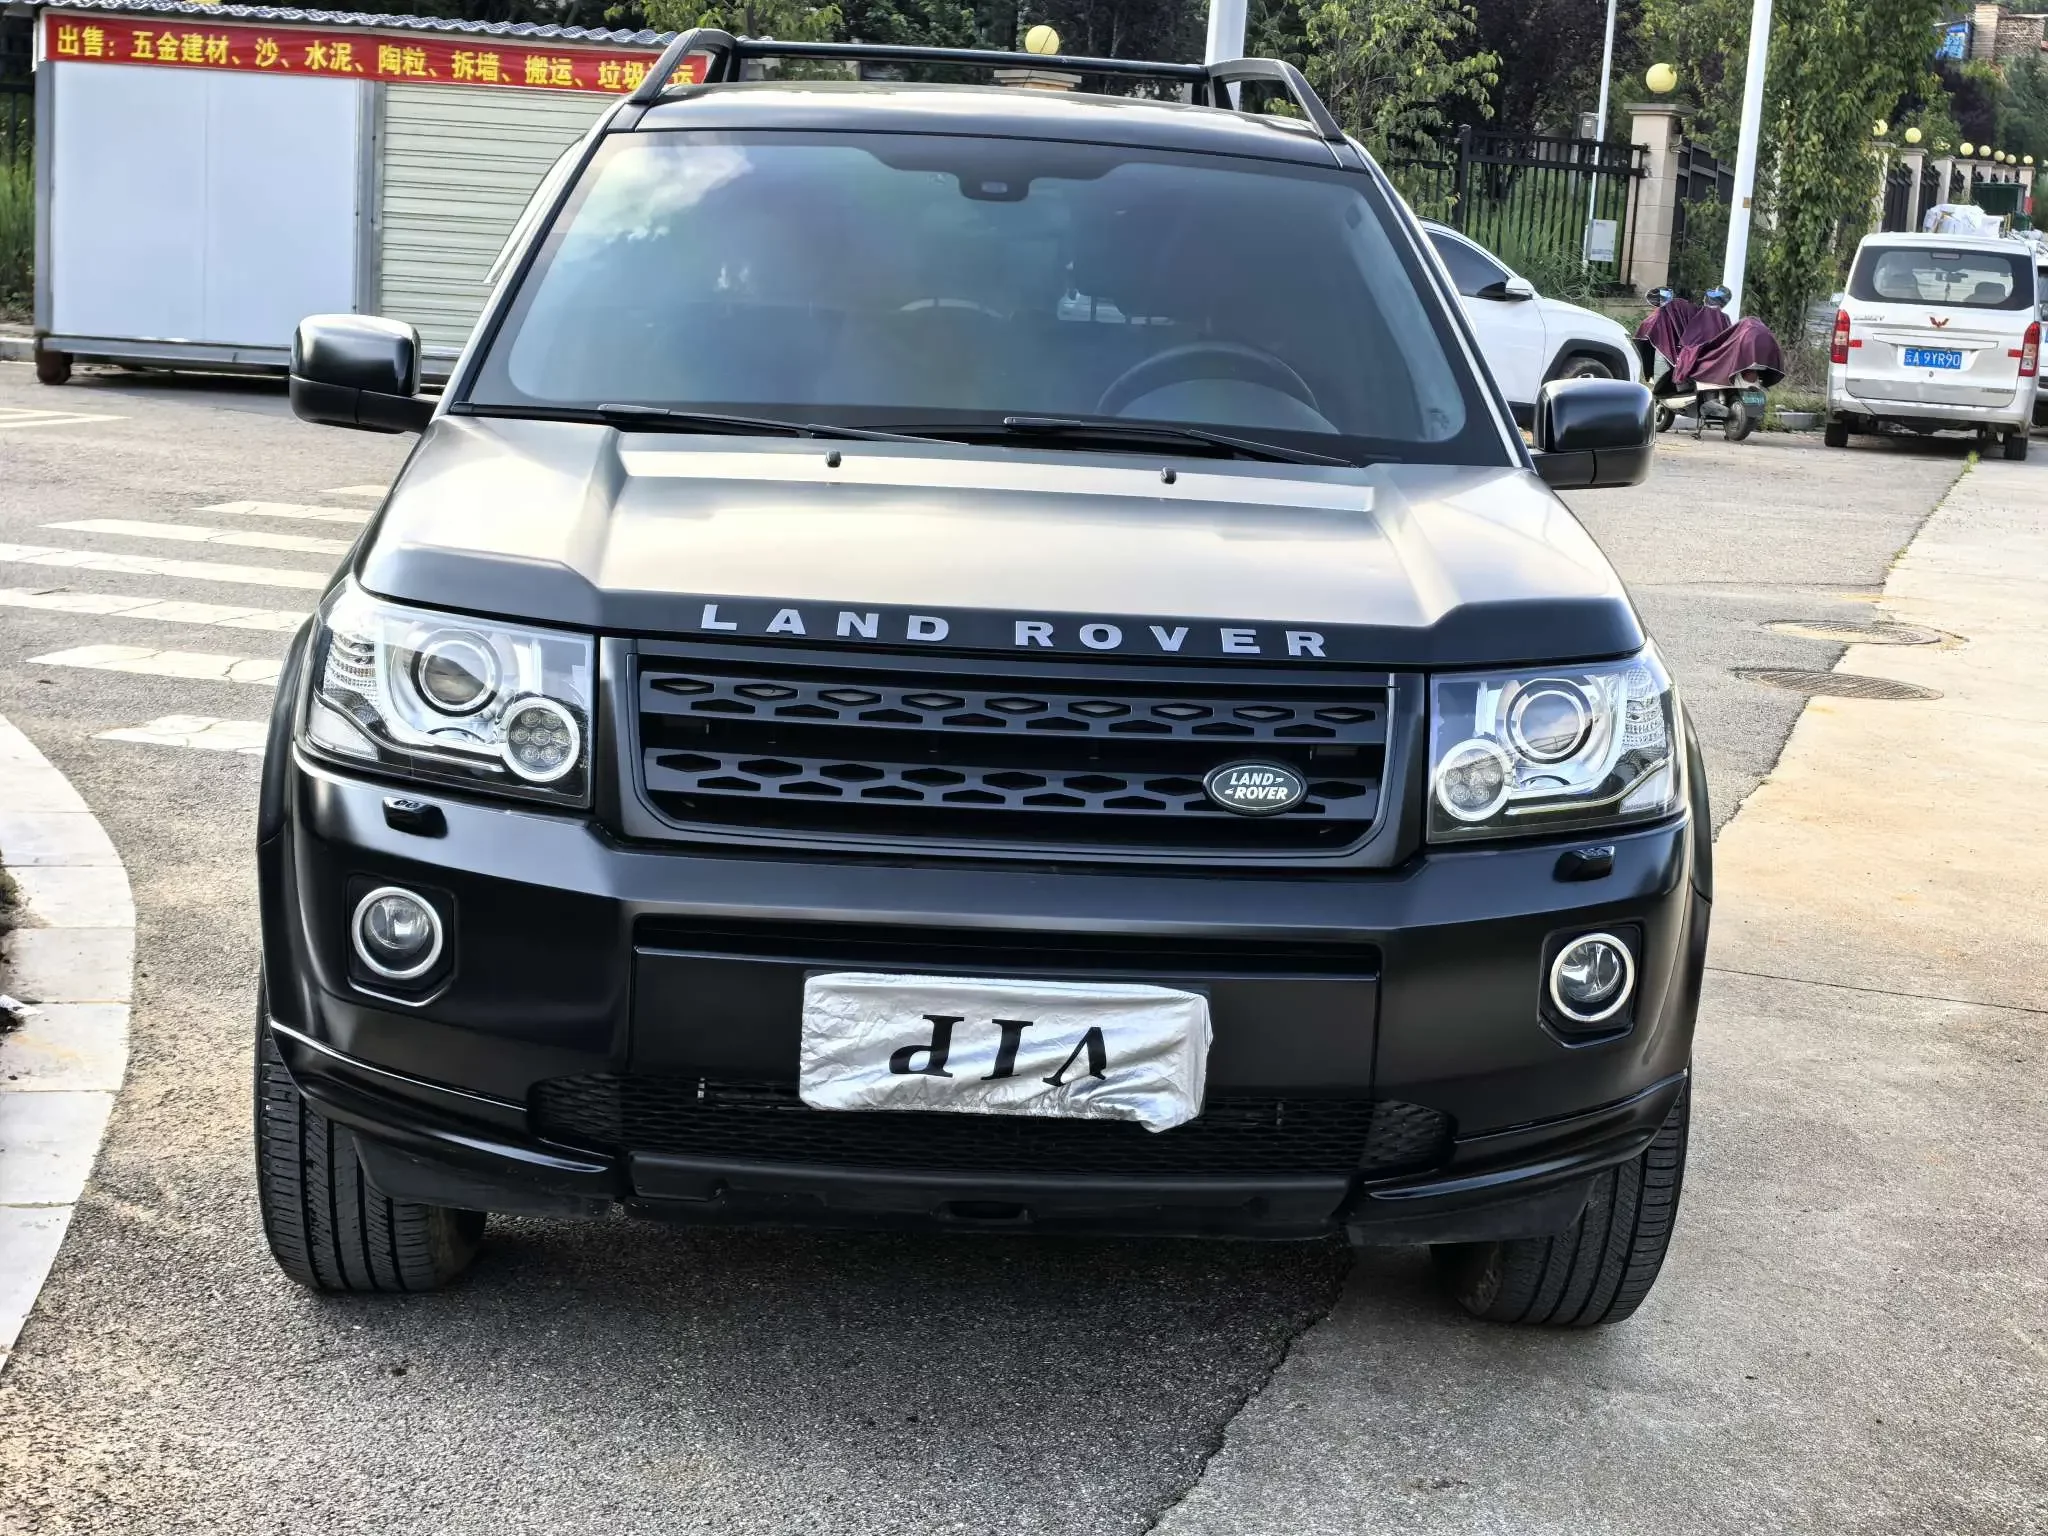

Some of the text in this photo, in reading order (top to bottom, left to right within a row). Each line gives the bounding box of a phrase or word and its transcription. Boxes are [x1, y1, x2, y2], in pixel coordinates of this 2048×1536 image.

[57, 24, 695, 90] 出售：五金建材、沙、水泥、陶粒、拆墙、搬运、垃圾运
[700, 603, 1327, 658] LAND ROVER
[888, 1014, 1107, 1087] VIP
